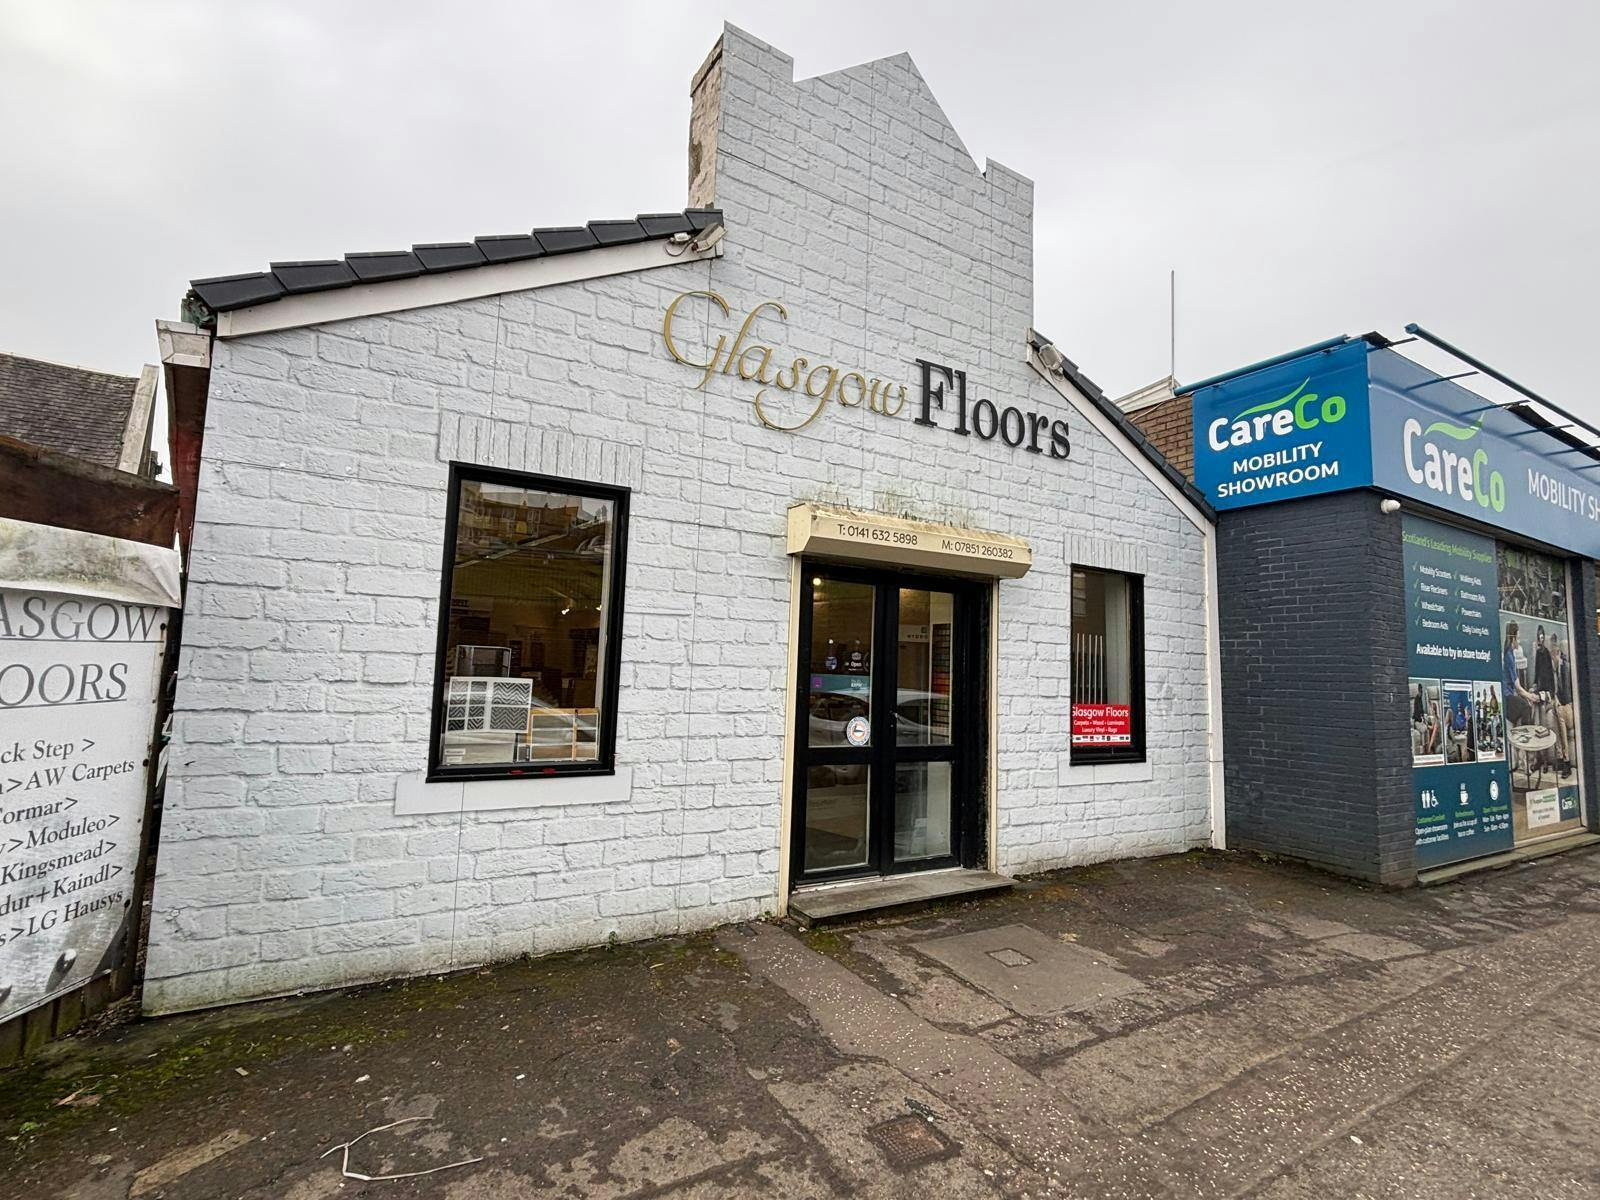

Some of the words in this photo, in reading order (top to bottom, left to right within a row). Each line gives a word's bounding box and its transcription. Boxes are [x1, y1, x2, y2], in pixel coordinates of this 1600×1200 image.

[663, 290, 907, 431] Glasgow
[914, 358, 1070, 460] Floors
[1208, 393, 1346, 451] CareCo
[1233, 441, 1323, 475] MOBILITY
[1403, 418, 1505, 513] CareCo
[1217, 461, 1339, 498] SHOWROOM
[1528, 468, 1586, 516] MOBILITY
[837, 523, 846, 536] T:
[847, 525, 869, 539] 0141
[872, 529, 890, 542] 632
[893, 532, 918, 546] 5898
[941, 539, 953, 551] M:
[954, 541, 980, 554] 07851
[981, 545, 1013, 559] 260382
[1416, 643, 1442, 657] Available
[1442, 645, 1449, 657] to
[1456, 646, 1462, 658] in
[1462, 648, 1475, 659] store
[1105, 706, 1129, 717] Floors
[32, 739, 74, 760] Step
[71, 760, 135, 782] Carpets
[63, 890, 123, 923] Hausys
